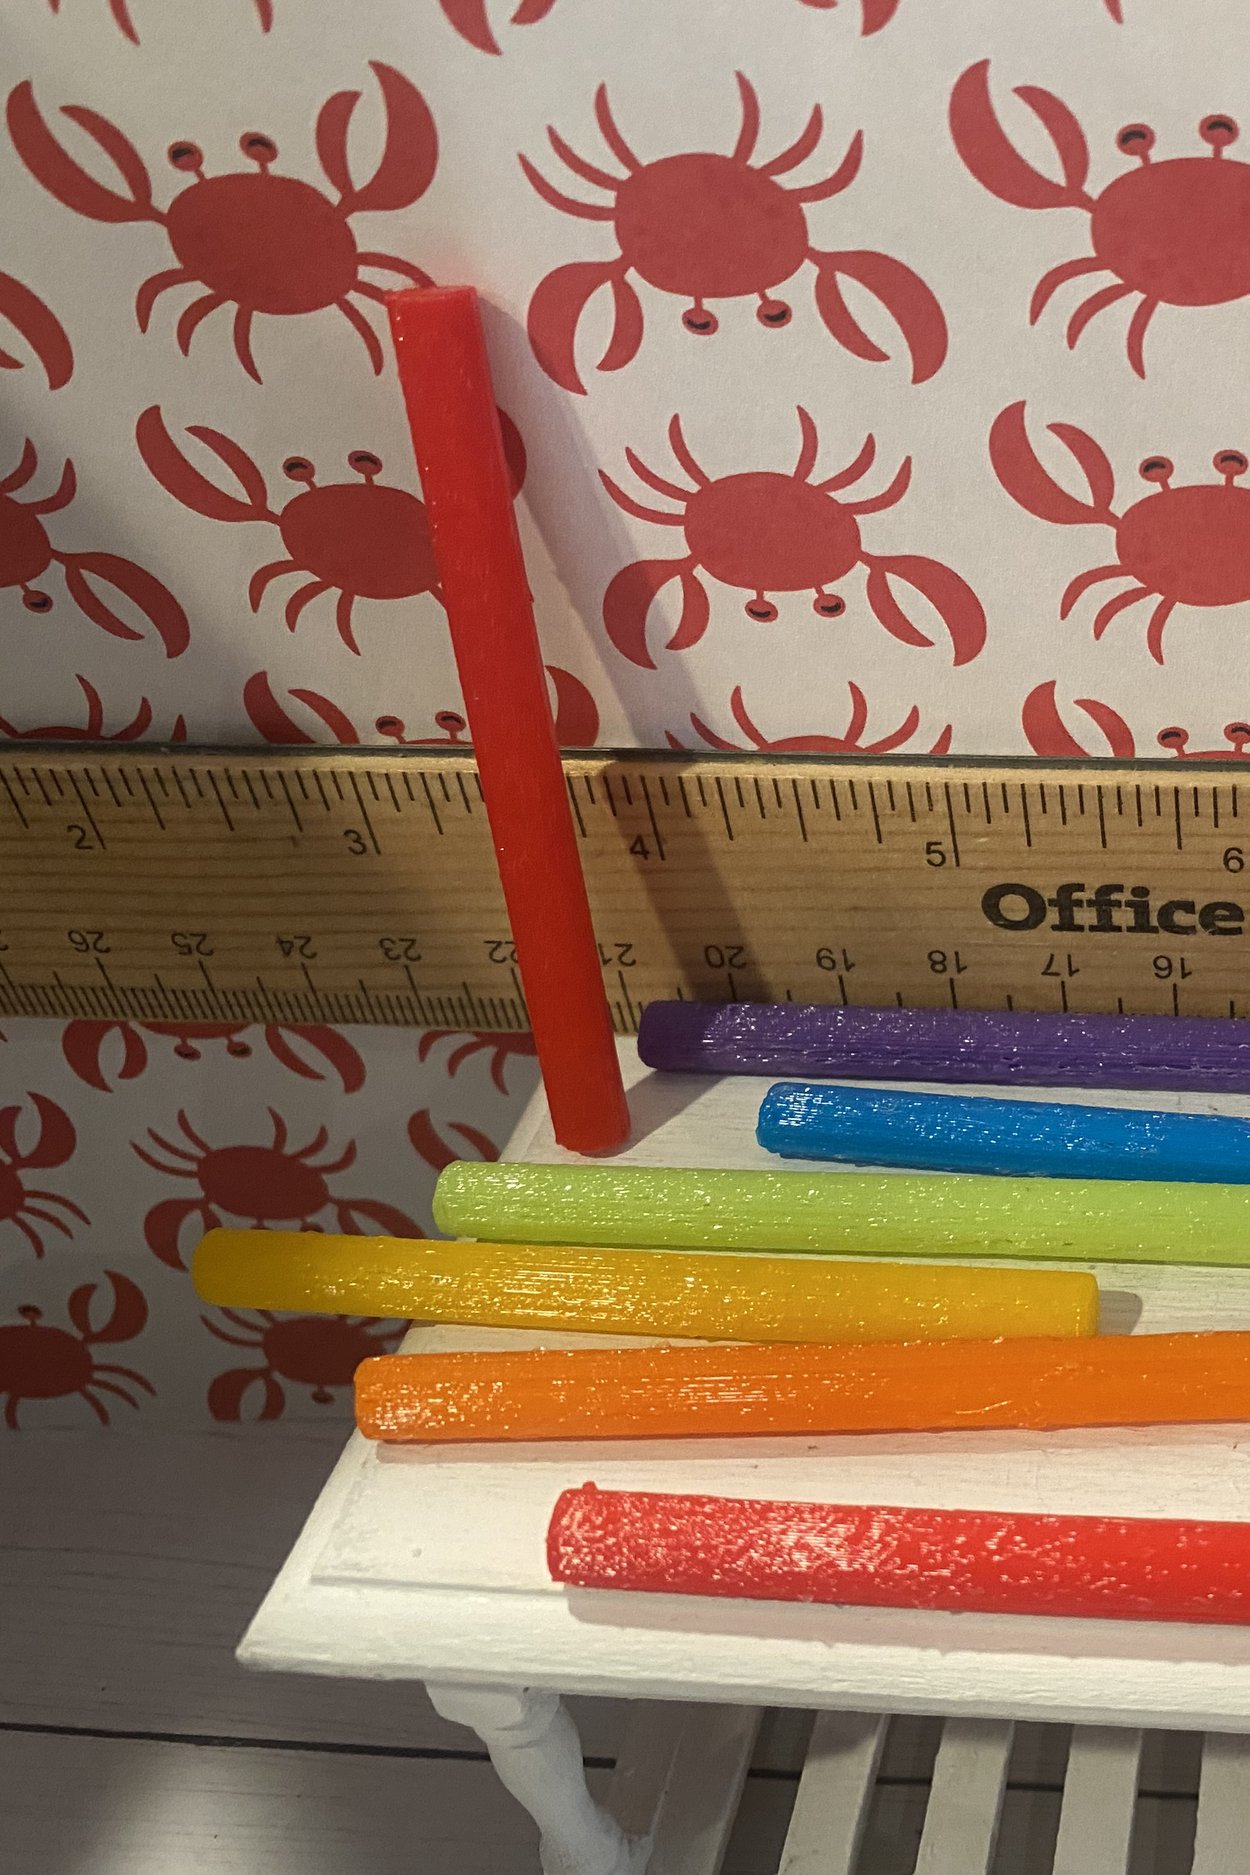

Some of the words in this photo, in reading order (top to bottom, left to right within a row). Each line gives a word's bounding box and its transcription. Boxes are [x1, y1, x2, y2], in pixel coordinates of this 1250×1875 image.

[67, 822, 94, 850] 2
[343, 829, 367, 856] 3
[629, 834, 650, 860] 4
[925, 841, 947, 868] 5
[1223, 847, 1245, 874] 6
[981, 882, 1245, 936] Office
[67, 929, 111, 954] 26
[171, 932, 215, 957] 25
[275, 935, 317, 959] 24
[378, 937, 422, 962] 23
[597, 943, 637, 967] 21
[704, 945, 747, 970] 20
[815, 947, 856, 972] 19
[927, 949, 968, 974] 18
[1040, 953, 1080, 977] 17
[1152, 955, 1193, 980] 16
